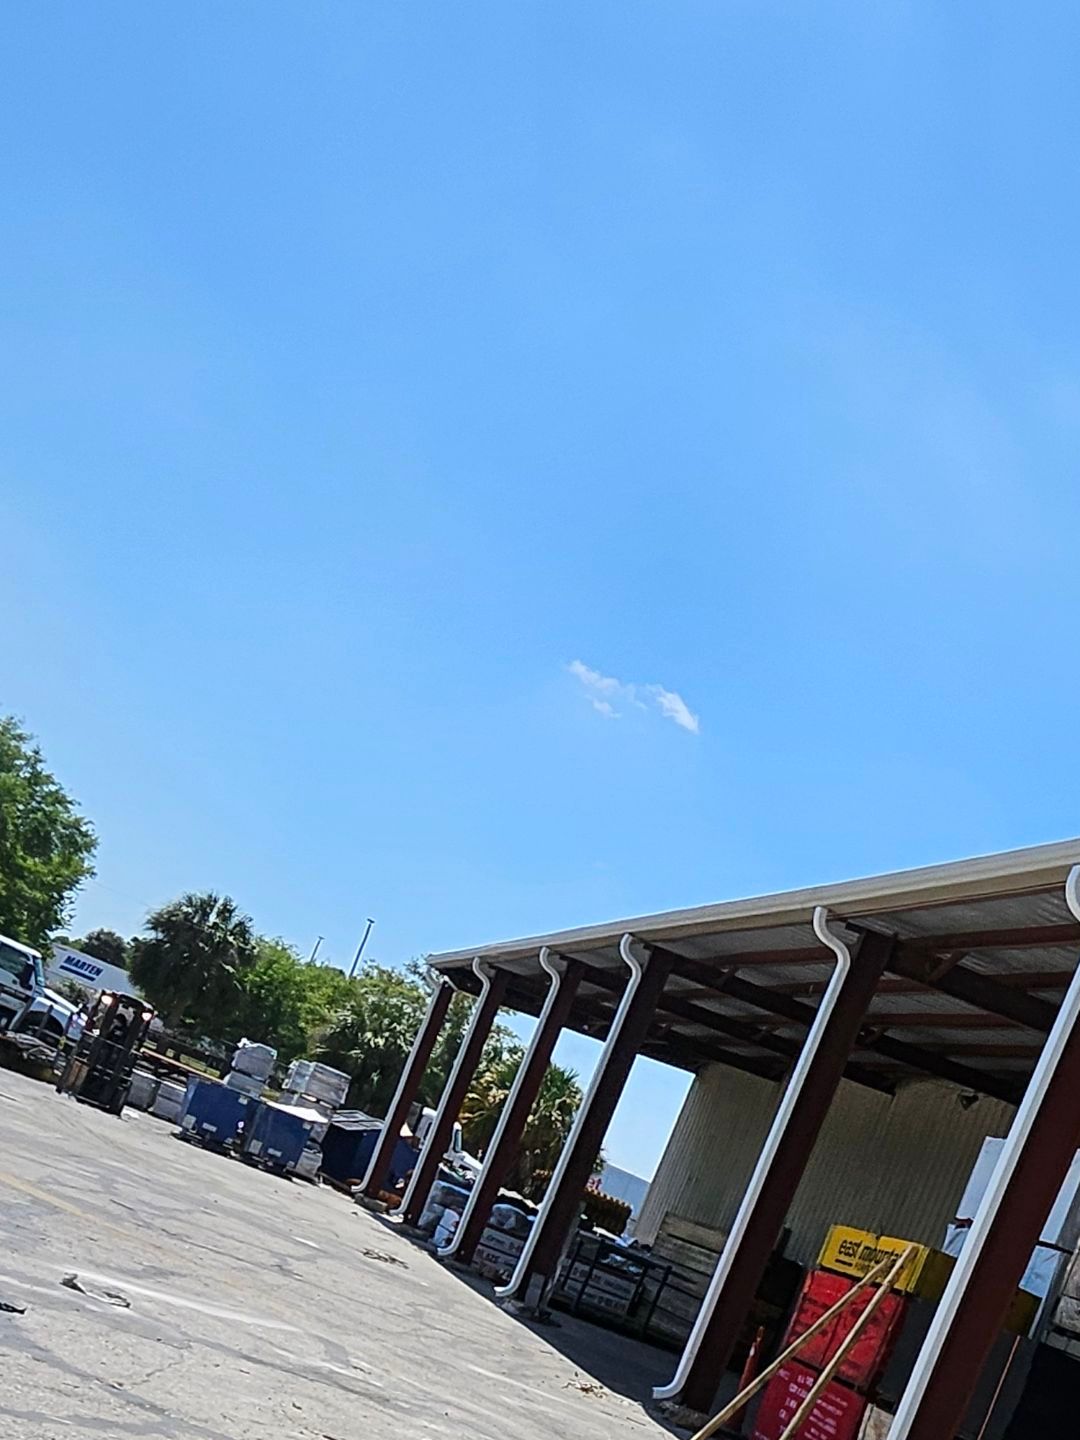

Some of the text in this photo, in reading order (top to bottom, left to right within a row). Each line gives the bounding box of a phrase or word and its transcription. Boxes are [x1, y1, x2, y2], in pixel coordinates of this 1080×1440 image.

[63, 955, 104, 977] MARTEN
[838, 1240, 862, 1259] east
[859, 1245, 904, 1268] mounta
